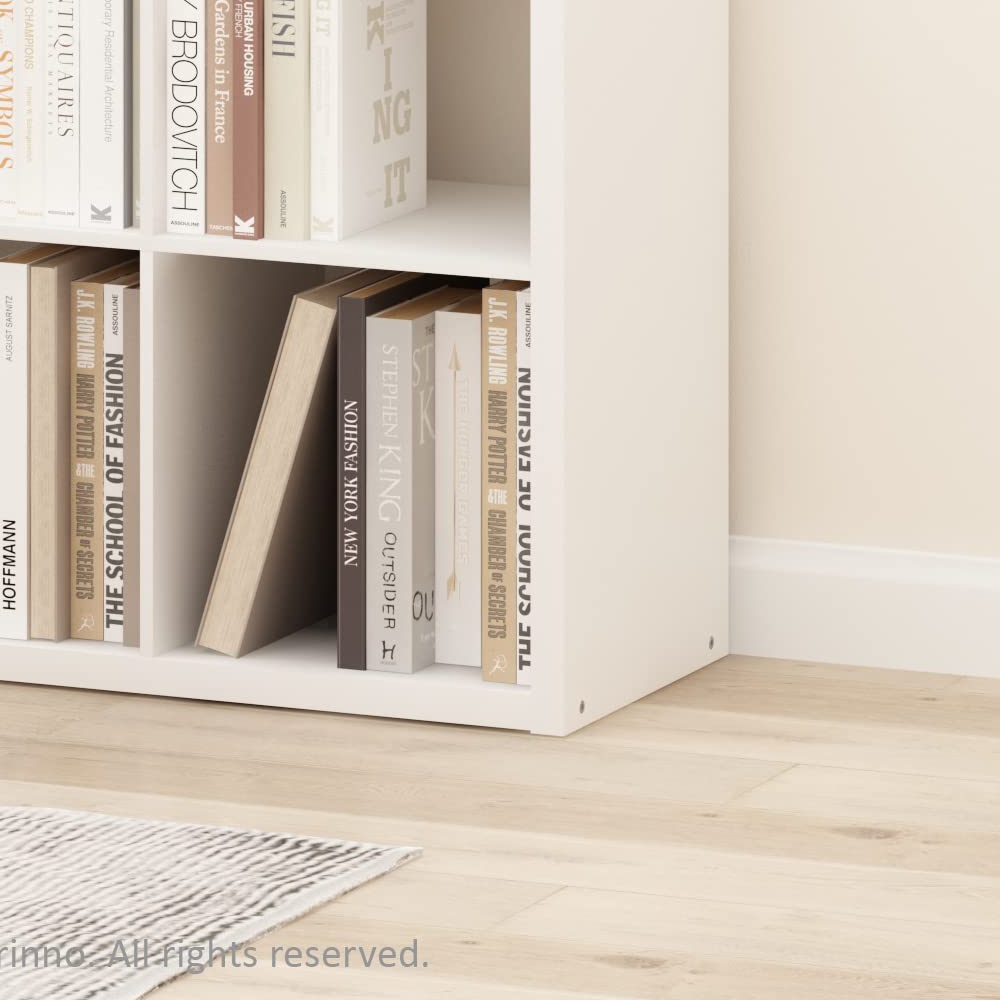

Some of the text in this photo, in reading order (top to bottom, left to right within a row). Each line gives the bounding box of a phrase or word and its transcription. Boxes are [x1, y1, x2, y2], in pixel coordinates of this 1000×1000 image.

[24, 7, 34, 70] CHAMPIONS
[234, 4, 243, 38] FRENCH
[244, 1, 254, 38] URBAN
[316, 16, 332, 37] IT
[104, 30, 115, 83] Residential
[215, 0, 230, 145] Gardens in France
[244, 40, 254, 97] HOUSING
[104, 85, 115, 143] Architecture
[171, 20, 199, 211] BRODOVITCH
[384, 157, 411, 209] IT
[5, 295, 14, 362] AUGUST SARNITZ
[76, 289, 96, 312] J.K.
[489, 296, 508, 323] J.K.
[76, 317, 96, 369] ROWLING
[488, 327, 508, 386] ROWLING
[76, 373, 96, 414] HARRY
[488, 390, 508, 434] HARRY
[76, 416, 96, 460] POTTER
[379, 344, 401, 523] STEPHEN KING
[488, 436, 508, 485] POTTER
[76, 482, 95, 538] CHAMBER
[106, 353, 124, 629] THE SCHOOL OF FASHION
[344, 400, 358, 567] NEW YORK FASHION
[3, 520, 17, 611] HOFFMANN
[488, 509, 507, 571] CHAMBER
[76, 551, 95, 600] SECRETS
[381, 533, 397, 629] OUTSIDER
[488, 583, 507, 639] SECRETS
